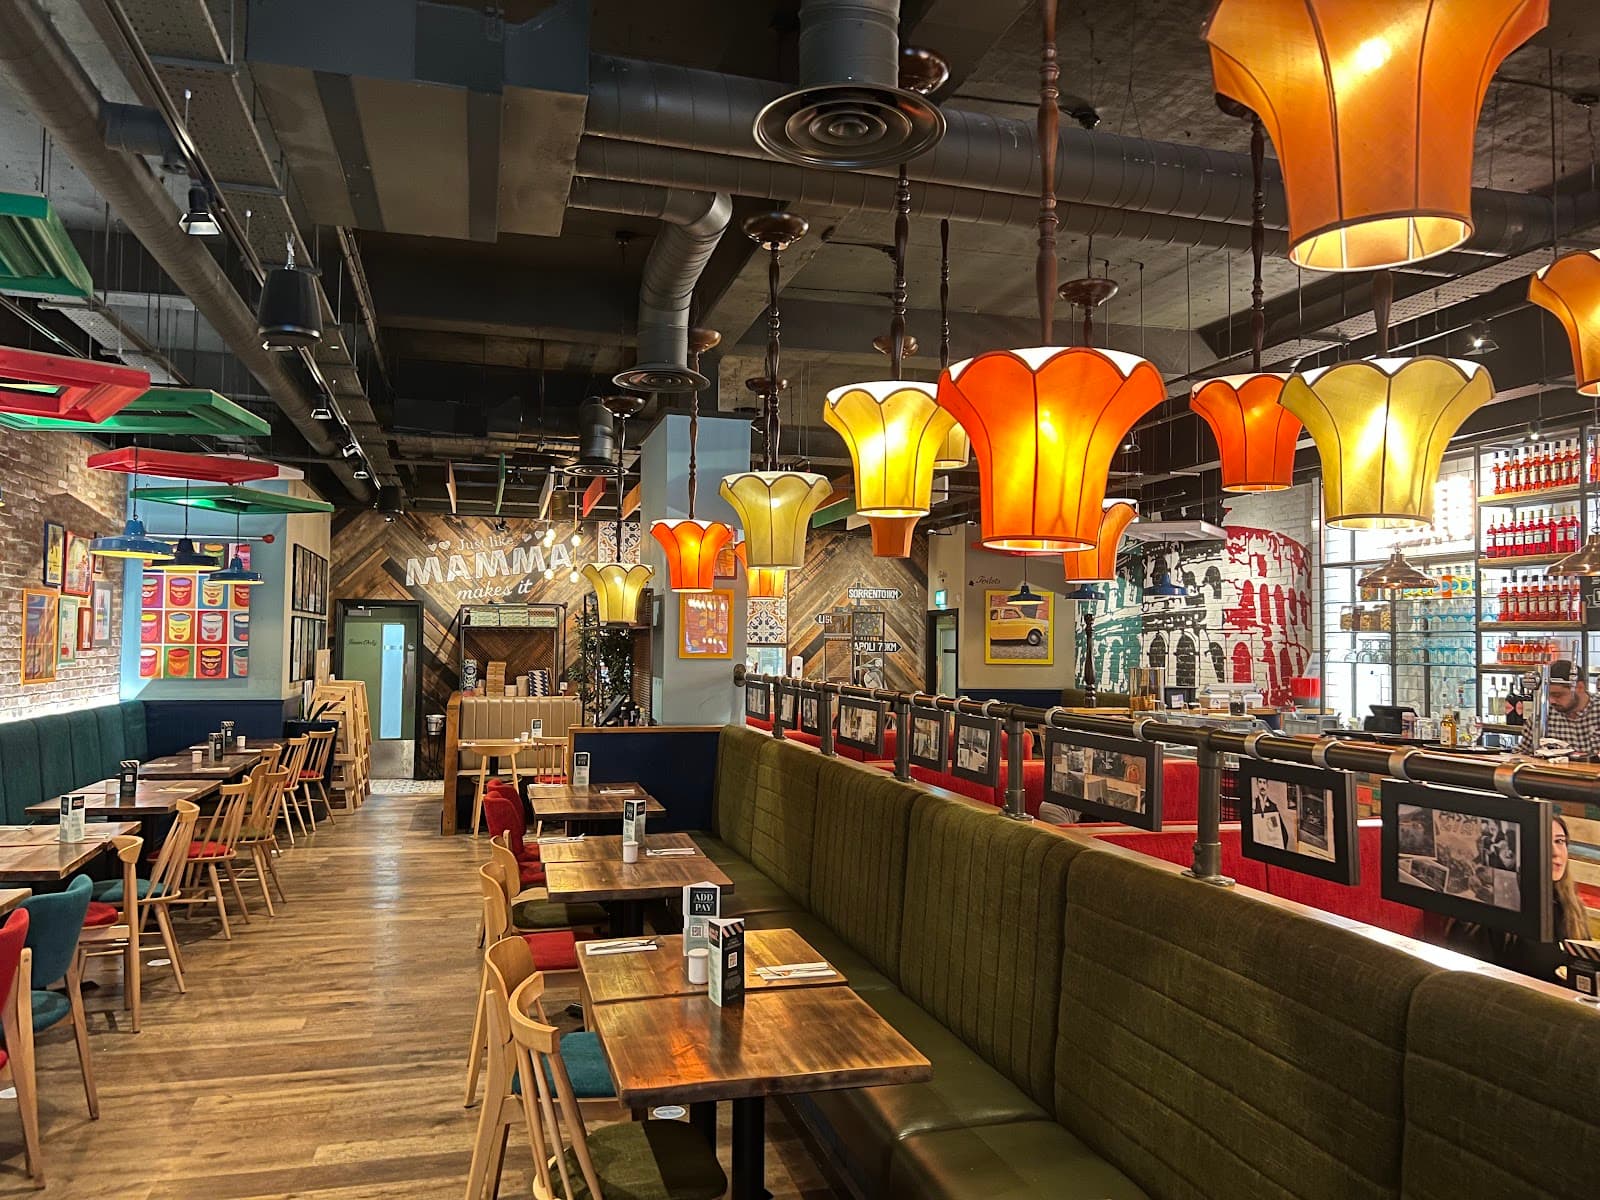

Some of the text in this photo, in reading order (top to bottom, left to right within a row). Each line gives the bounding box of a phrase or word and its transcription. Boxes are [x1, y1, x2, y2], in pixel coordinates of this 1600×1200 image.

[457, 535, 513, 551] Just like
[406, 543, 572, 586] MAMMA
[456, 579, 533, 600] makes it
[848, 589, 886, 598] SORRENTO
[694, 893, 714, 901] ADD
[694, 903, 713, 912] PAY
